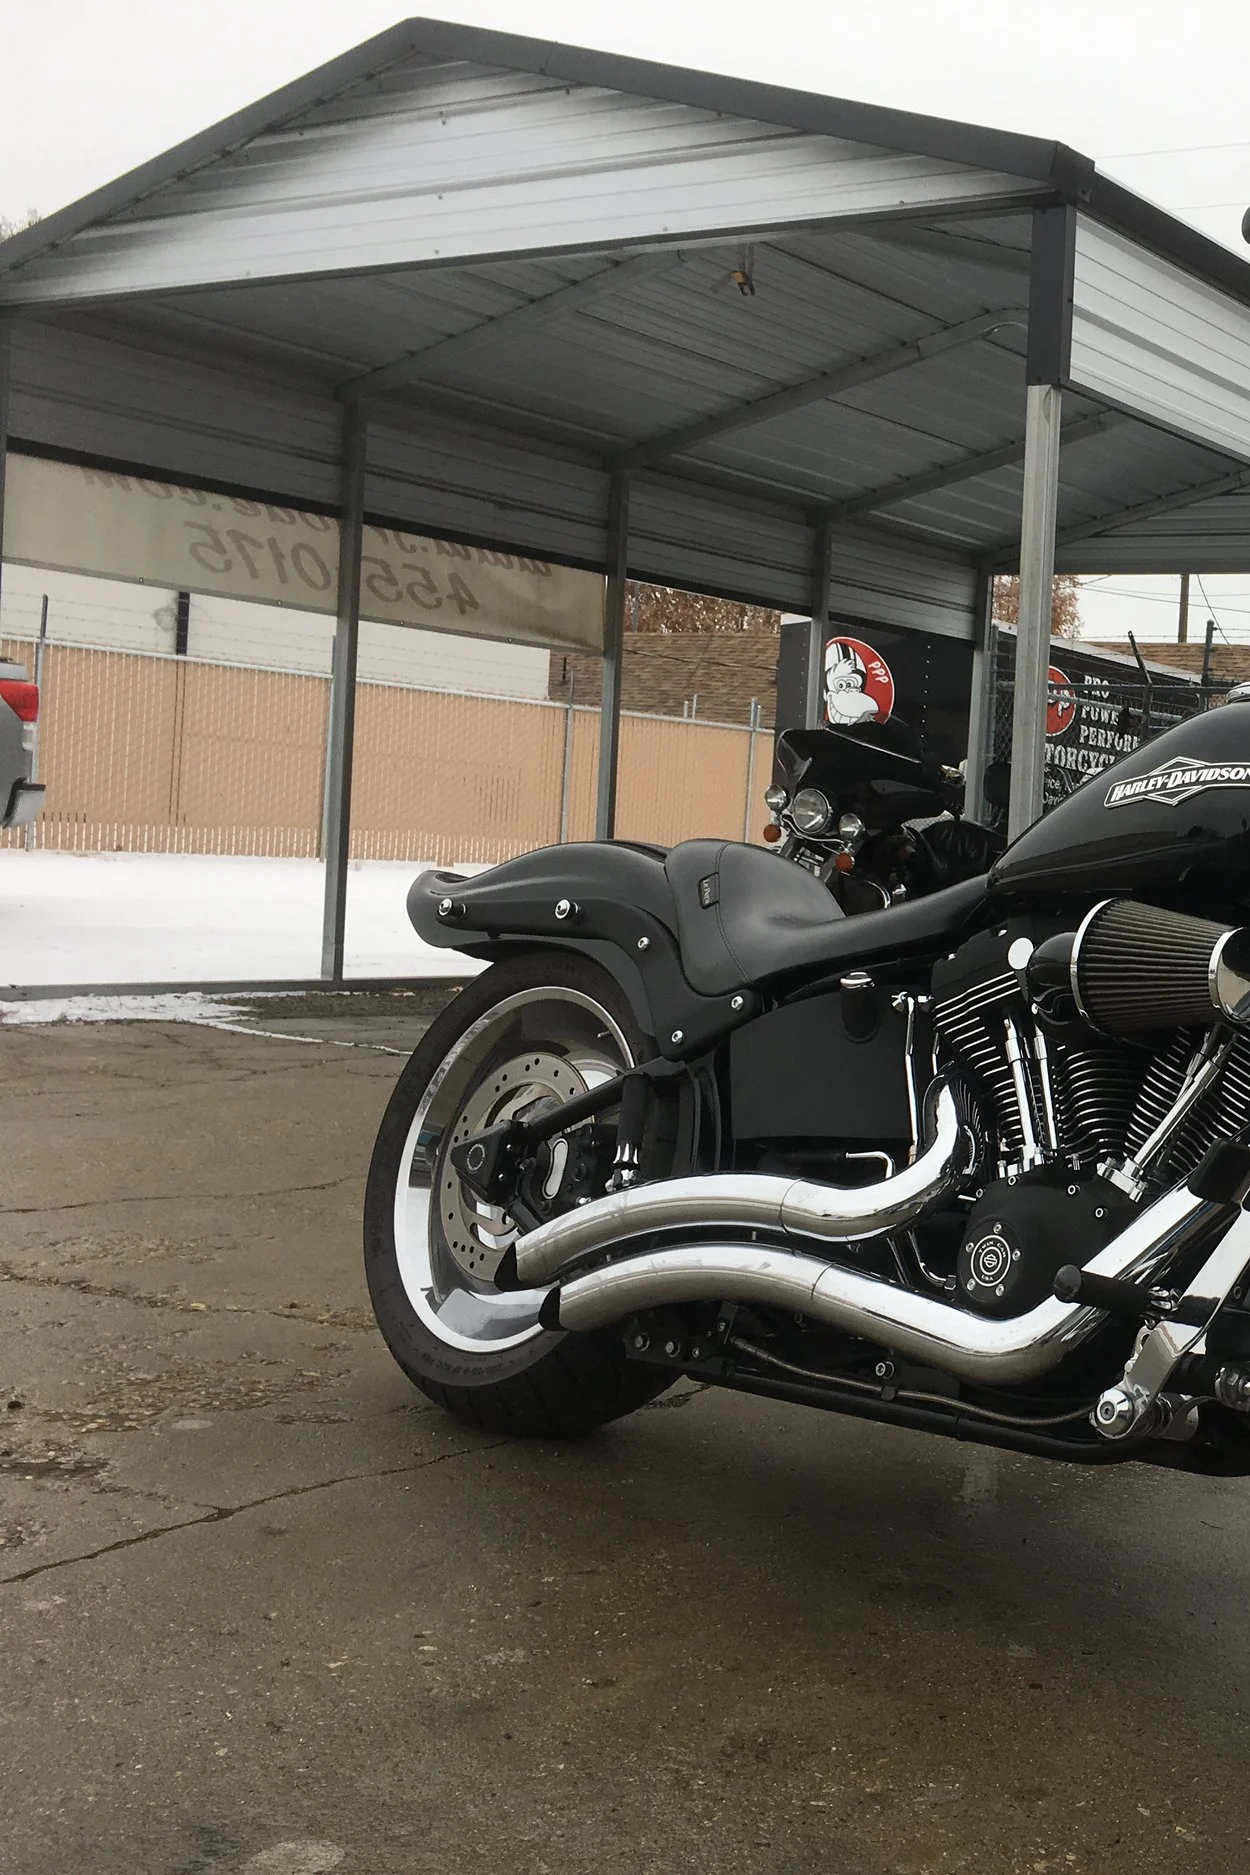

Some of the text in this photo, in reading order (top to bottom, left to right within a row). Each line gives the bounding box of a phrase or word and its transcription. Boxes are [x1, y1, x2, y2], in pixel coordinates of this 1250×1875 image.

[867, 660, 889, 683] PPP
[1080, 704, 1119, 726] POWE
[1044, 742, 1116, 773] TORCYC
